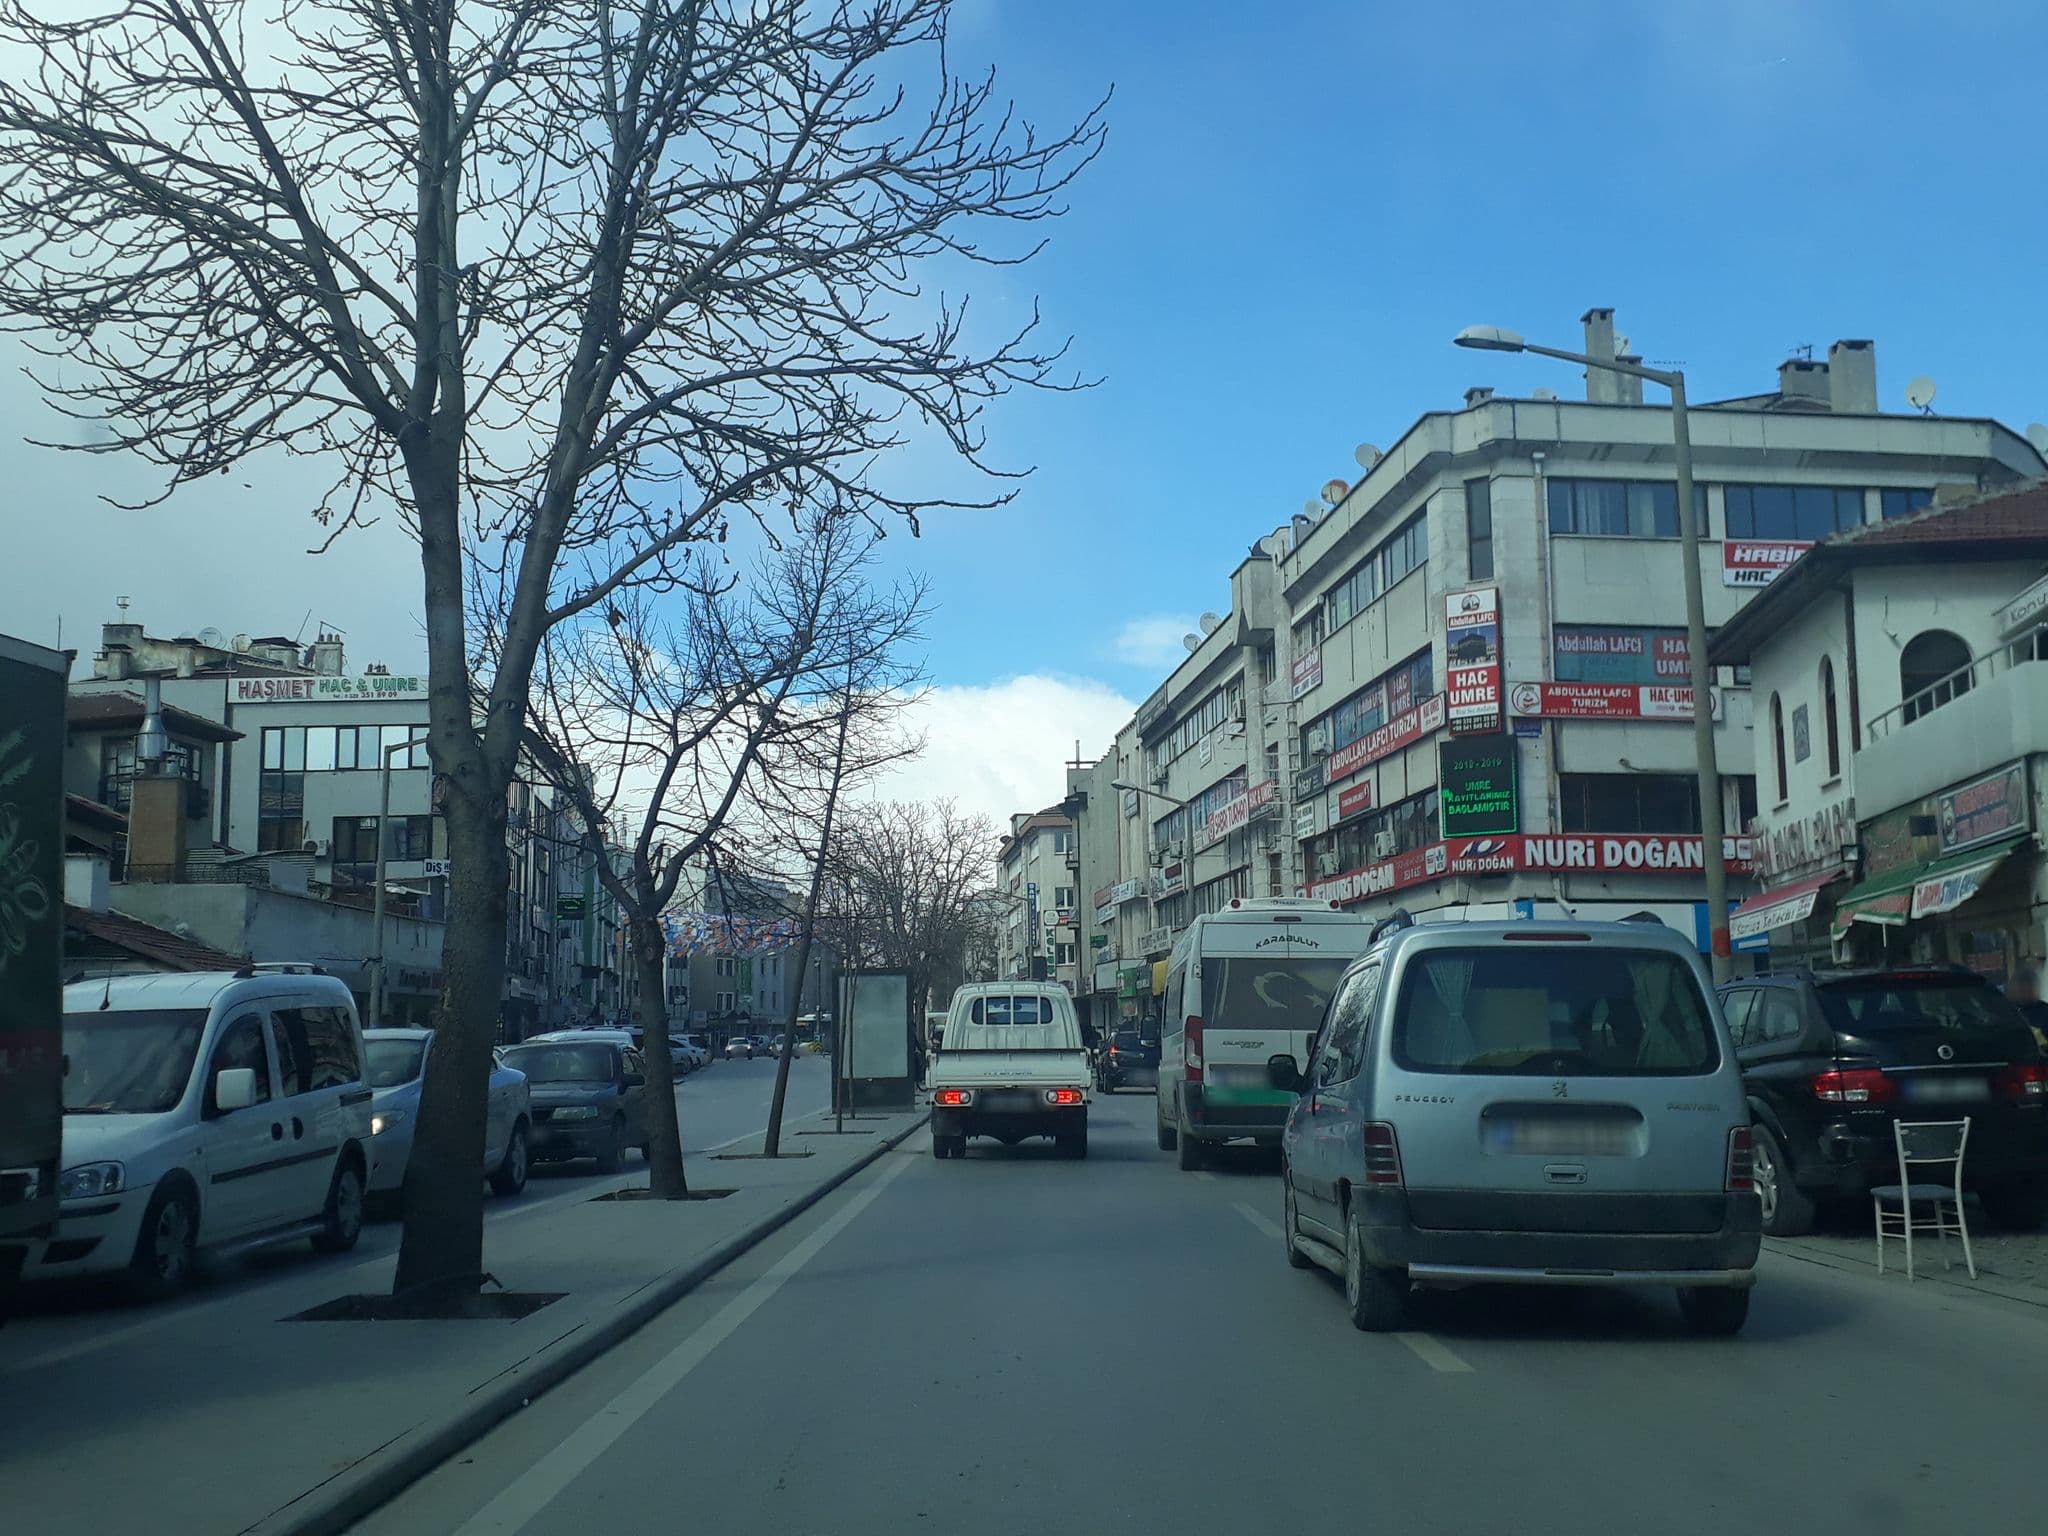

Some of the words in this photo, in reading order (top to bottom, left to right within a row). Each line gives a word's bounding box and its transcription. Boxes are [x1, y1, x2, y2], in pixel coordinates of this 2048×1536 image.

[1734, 571, 1772, 582] HAC
[1450, 614, 1476, 627] Abdullah
[1557, 634, 1608, 651] Abdullah
[1610, 636, 1642, 654] LAFCI
[1656, 659, 1691, 674] UM
[319, 679, 352, 693] HAC
[356, 678, 368, 692] &
[372, 677, 418, 692] UMRE
[1393, 672, 1408, 696] HAC
[1456, 670, 1488, 688] HAC
[1450, 686, 1496, 706] UMRE
[1548, 687, 1600, 697] ABDULLAH
[1602, 687, 1632, 698] LAFCI
[1649, 687, 1695, 704] HAC-UM
[1331, 738, 1367, 773] ABDULLAH
[1603, 838, 1704, 868] DOĞAN
[1478, 855, 1514, 870] DOĞAN
[1256, 933, 1320, 950] KARABULUT
[1395, 1094, 1455, 1105] PEUGEOT
